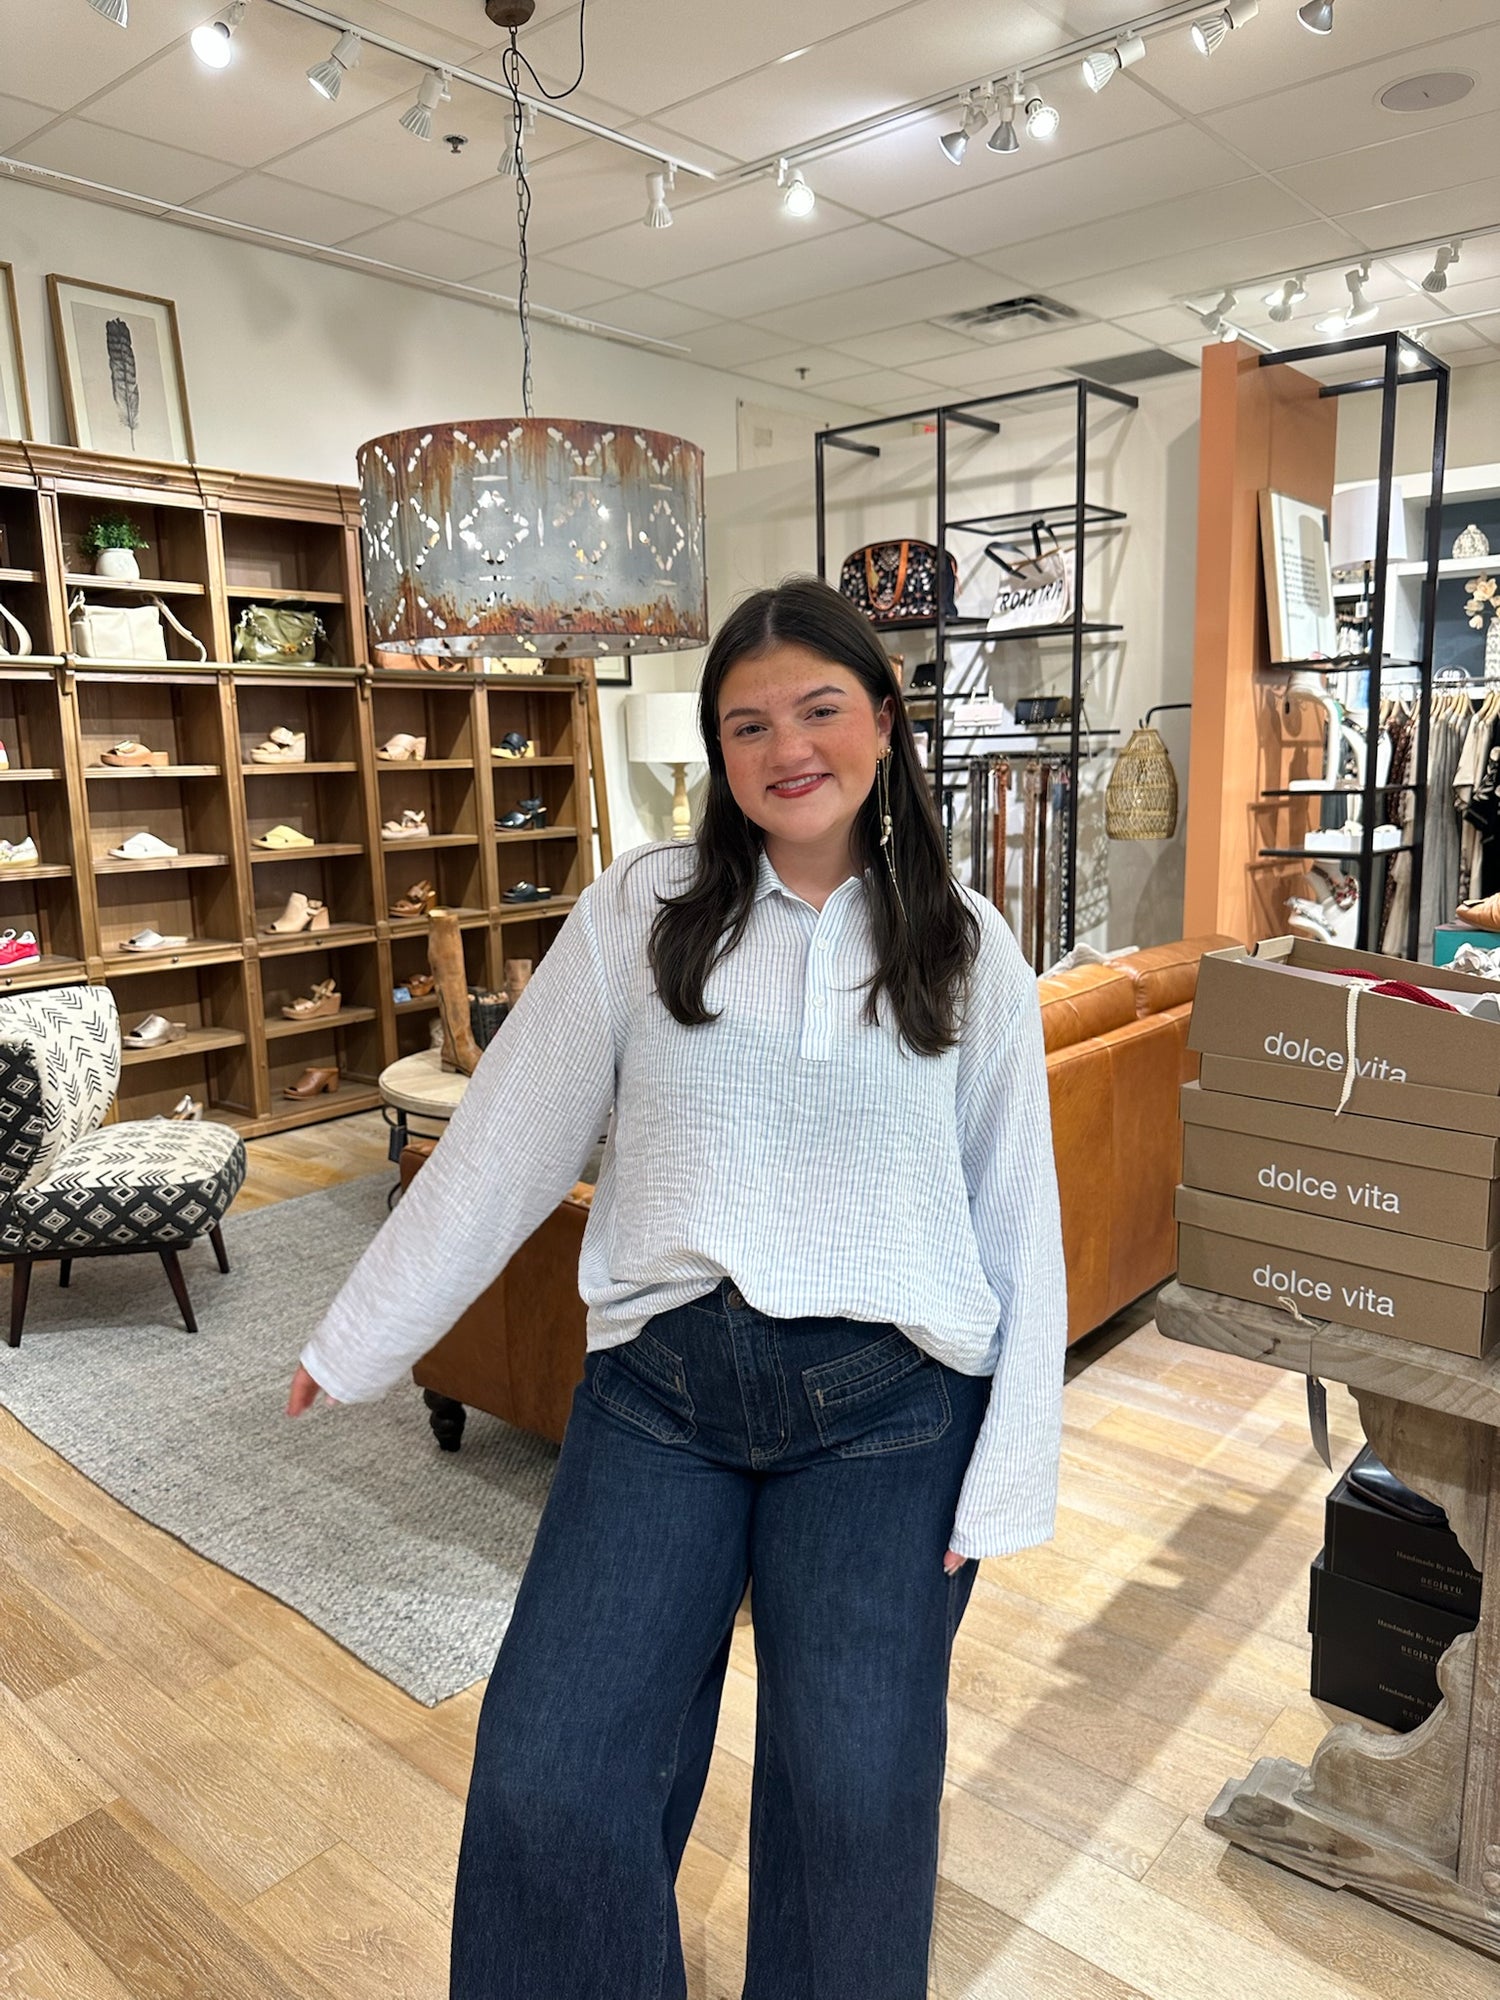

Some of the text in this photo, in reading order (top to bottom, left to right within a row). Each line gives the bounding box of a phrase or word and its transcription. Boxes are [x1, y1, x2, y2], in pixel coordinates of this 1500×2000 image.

[1000, 588, 1037, 612] ROAD
[1264, 1032, 1407, 1083] dolce vita
[1258, 1164, 1400, 1214] dolce vita
[1253, 1264, 1395, 1317] dolce vita
[1396, 1550, 1435, 1568] Handmade
[1436, 1562, 1445, 1572] By
[1447, 1566, 1464, 1577] Real
[1377, 1618, 1414, 1637] Handmade
[1379, 1683, 1415, 1702] Handmade
